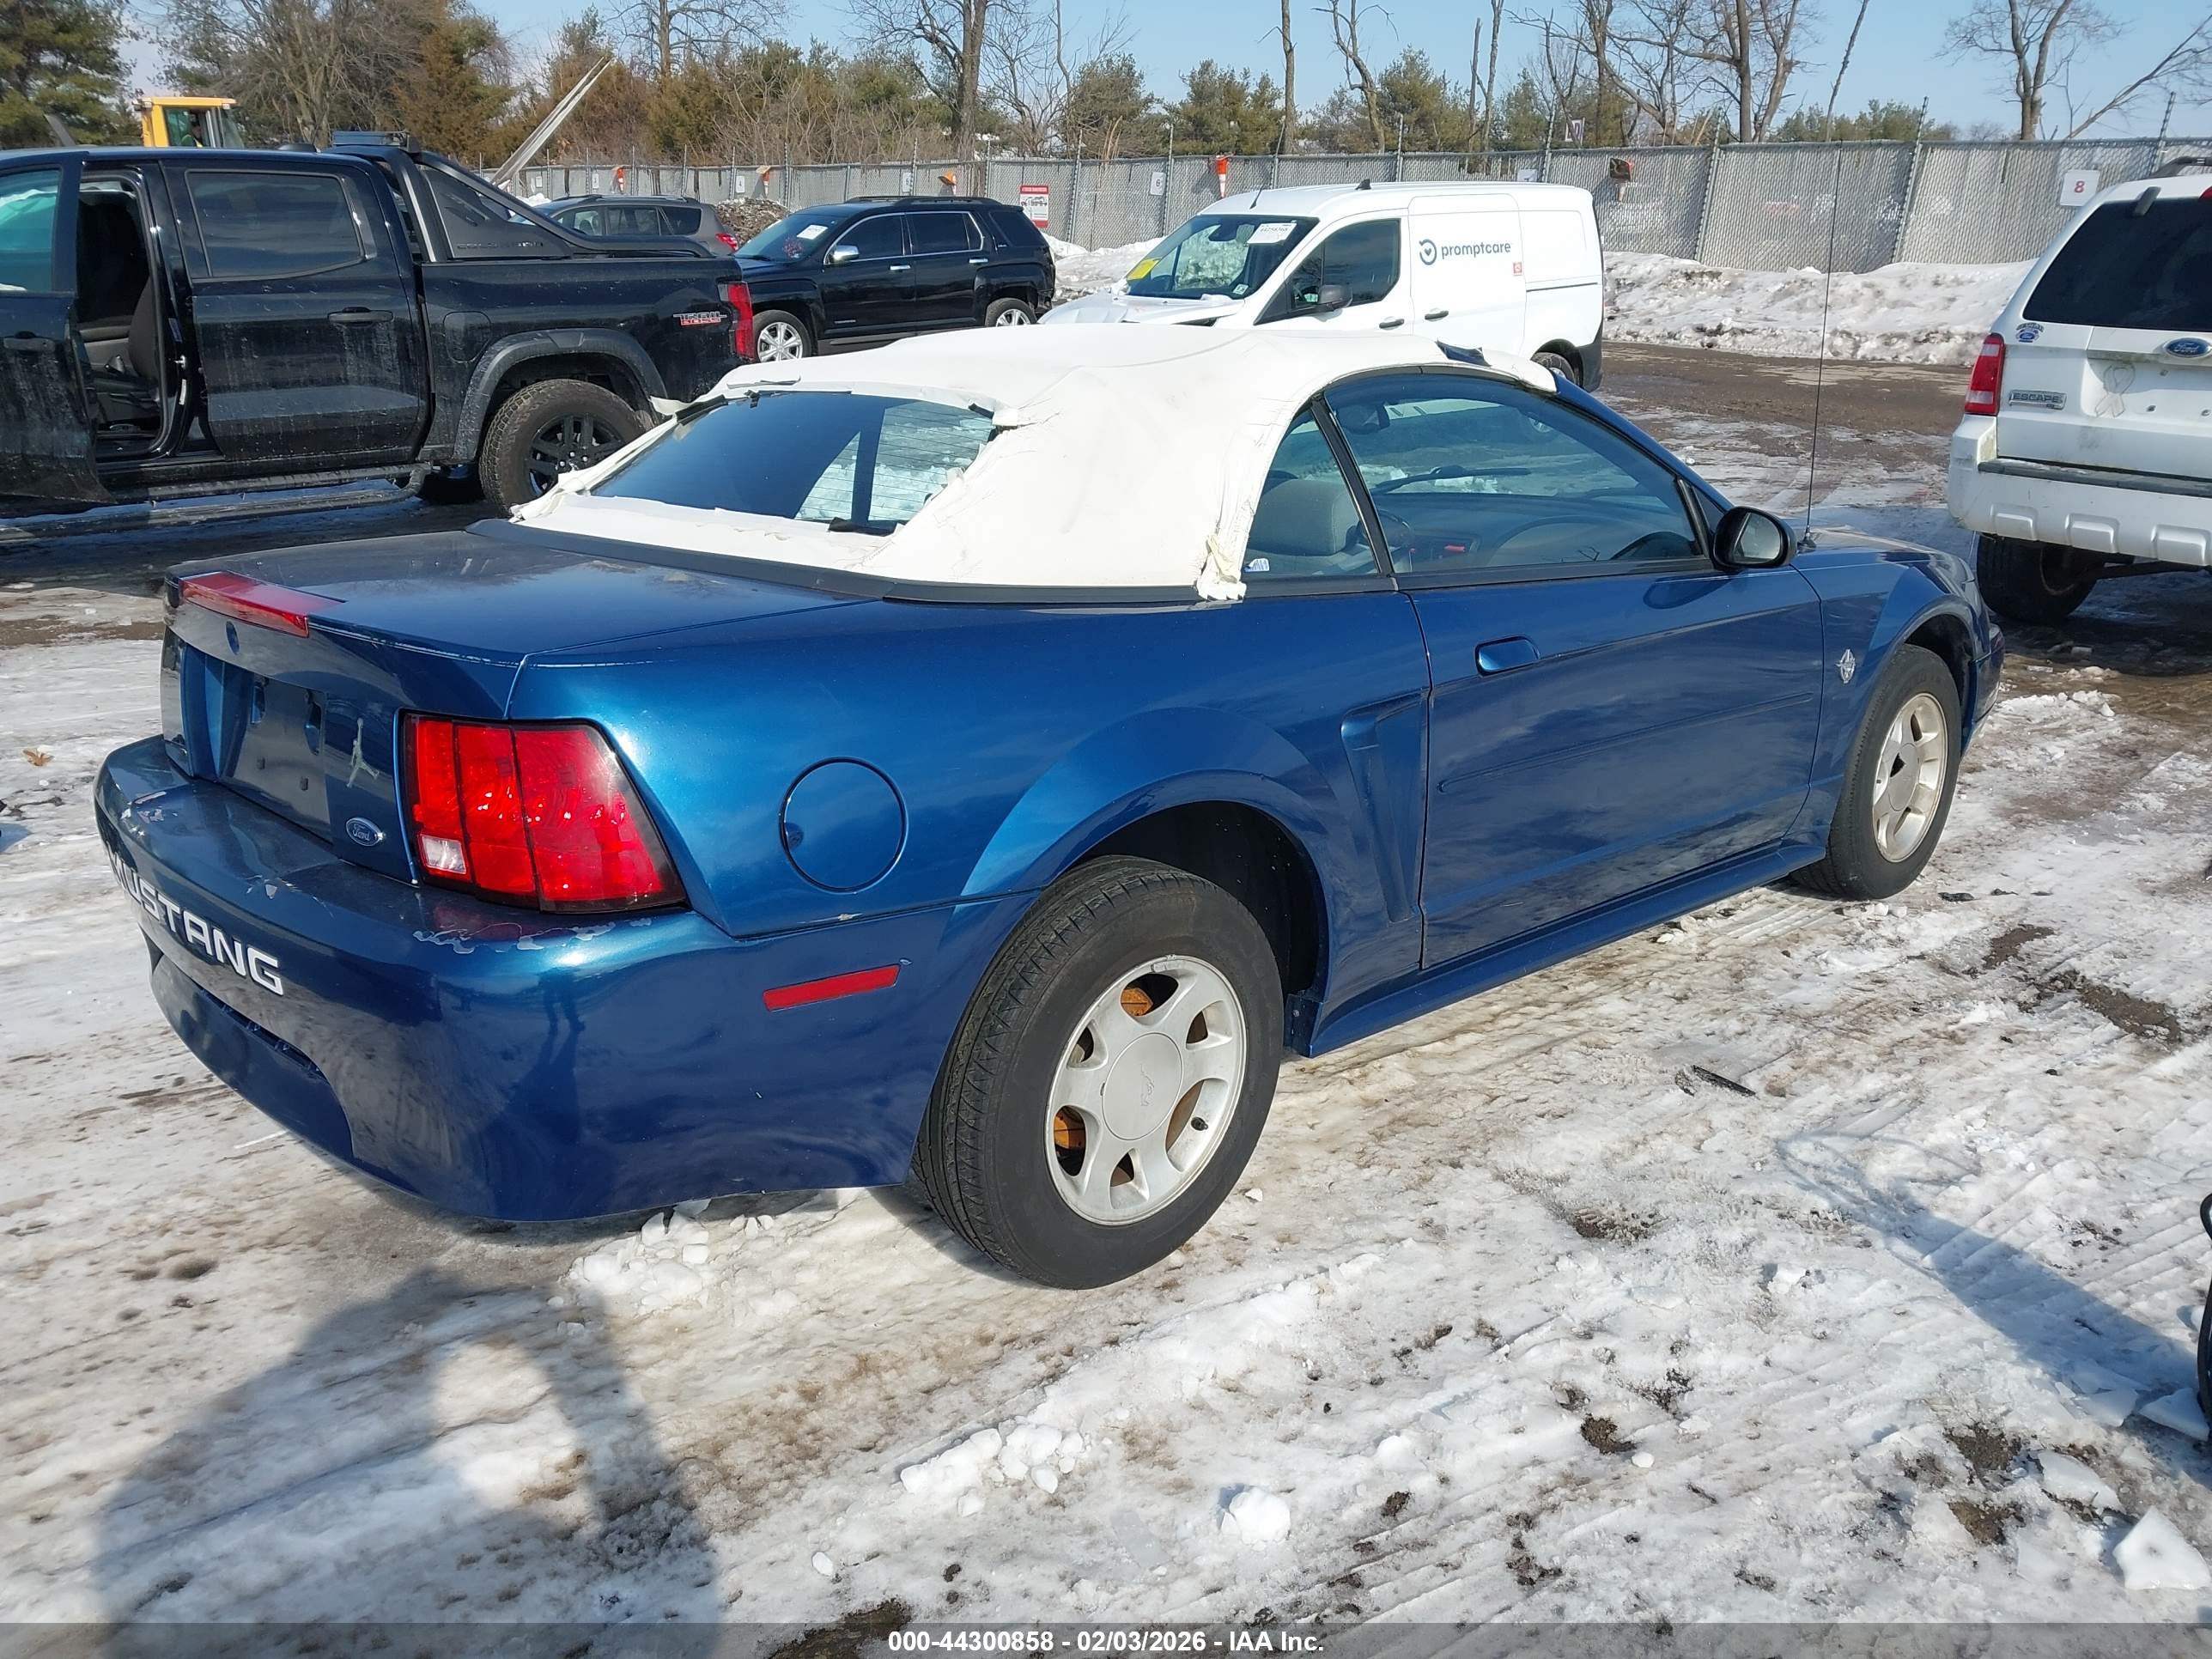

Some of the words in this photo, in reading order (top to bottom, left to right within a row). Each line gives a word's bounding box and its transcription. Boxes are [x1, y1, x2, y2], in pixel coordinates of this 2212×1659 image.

[2074, 180, 2085, 193] 8
[1441, 242, 1511, 260] promptcare
[672, 311, 728, 320] TRAIL
[681, 318, 721, 326] BOSS
[2013, 392, 2063, 404] ESCAPE
[112, 851, 283, 996] MUSTANG
